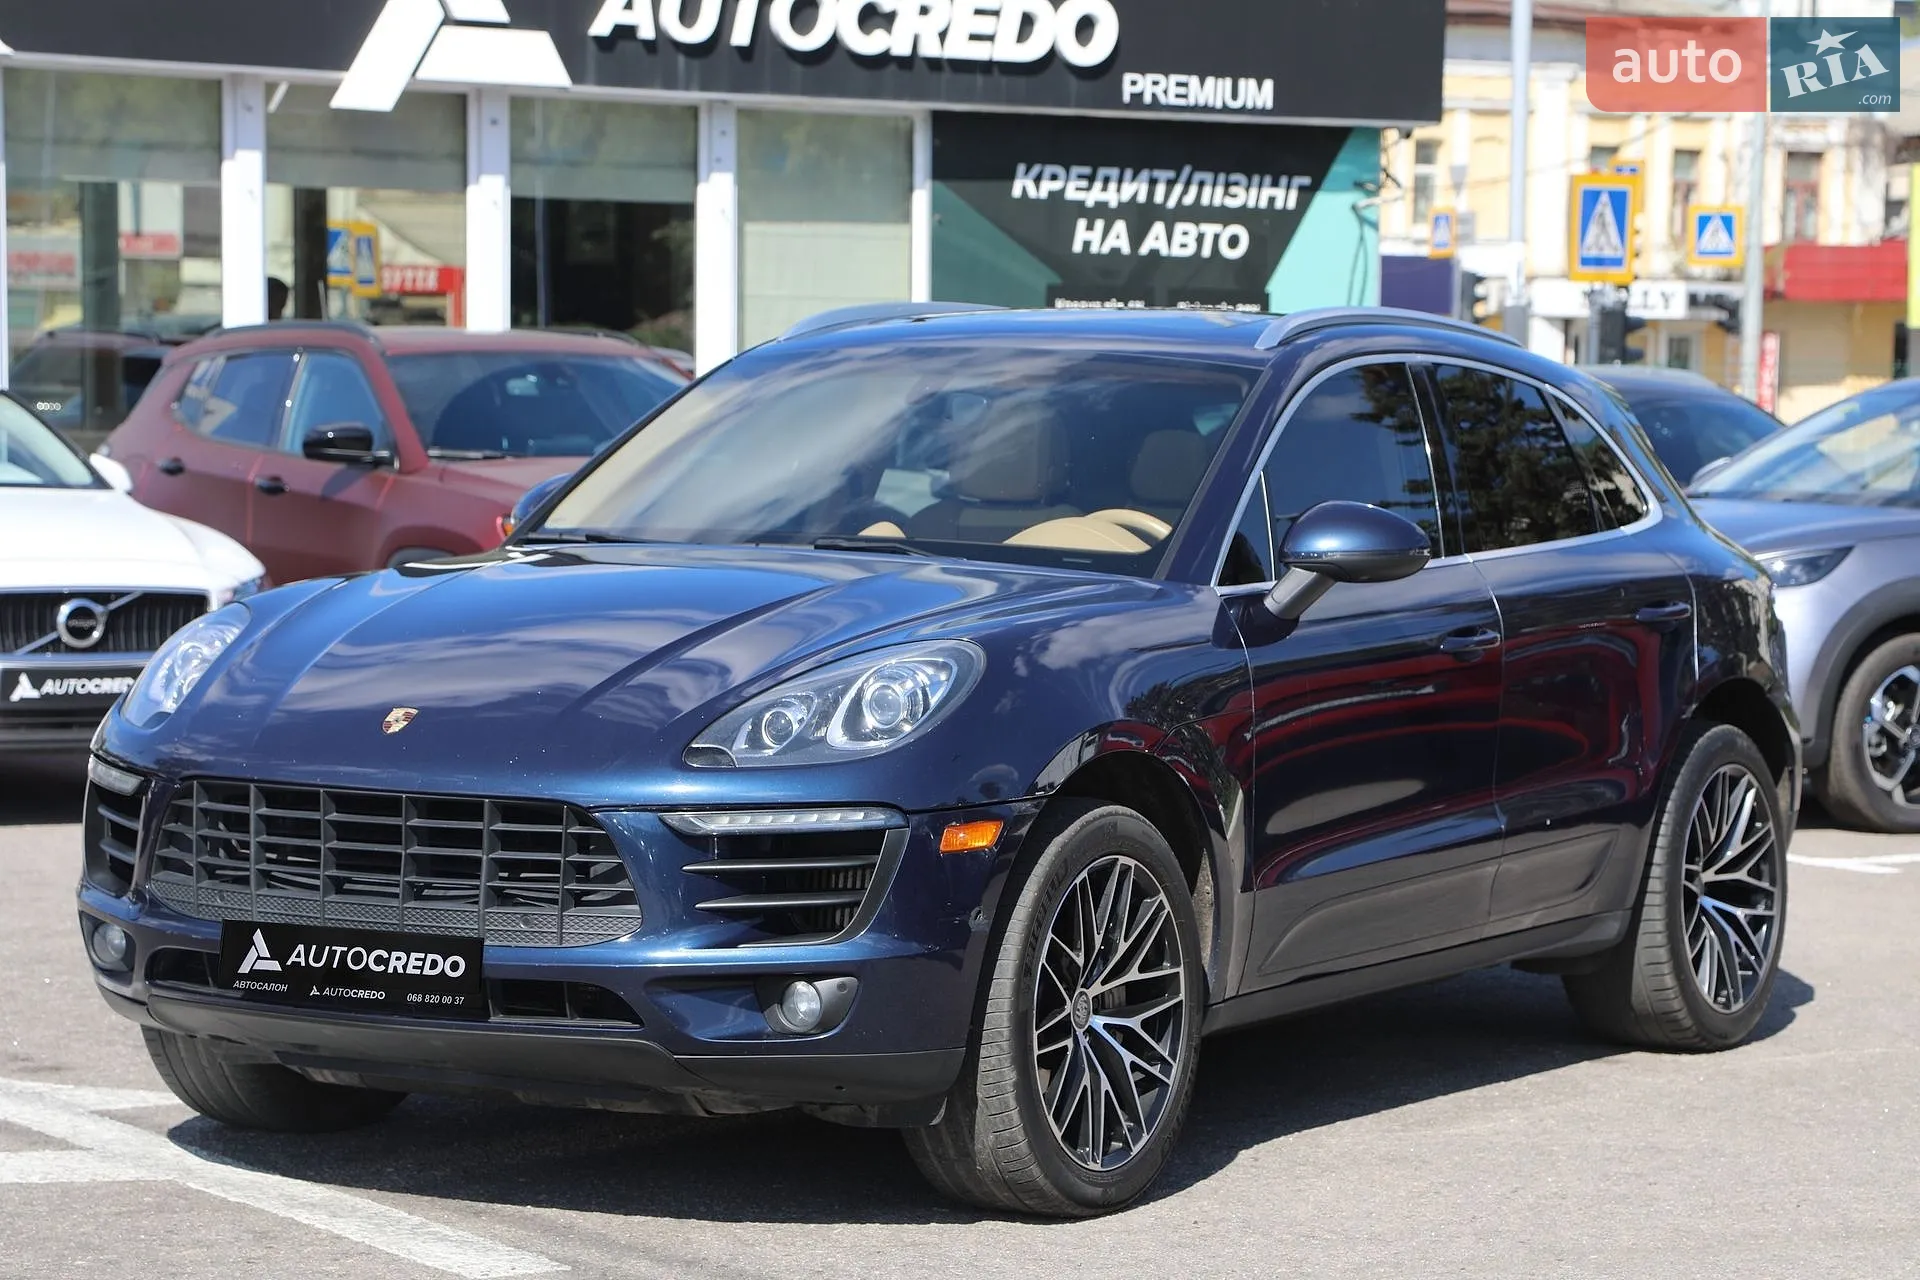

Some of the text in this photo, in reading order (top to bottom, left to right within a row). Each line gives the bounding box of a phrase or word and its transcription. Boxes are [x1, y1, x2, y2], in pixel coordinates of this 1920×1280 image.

[588, 0, 1120, 68] AUTOCREDO
[1121, 72, 1275, 110] PREMIUM
[1011, 163, 1312, 210] КРЕДИТ/ЛІЗІНГ
[1071, 217, 1250, 260] НА АВТО
[286, 944, 466, 978] AUTOCREDO
[233, 980, 288, 992] АВТОСАЛОН
[323, 987, 386, 1000] AUTOCREDO
[424, 994, 440, 1003] 820
[441, 995, 453, 1004] 00
[454, 996, 465, 1005] 37
